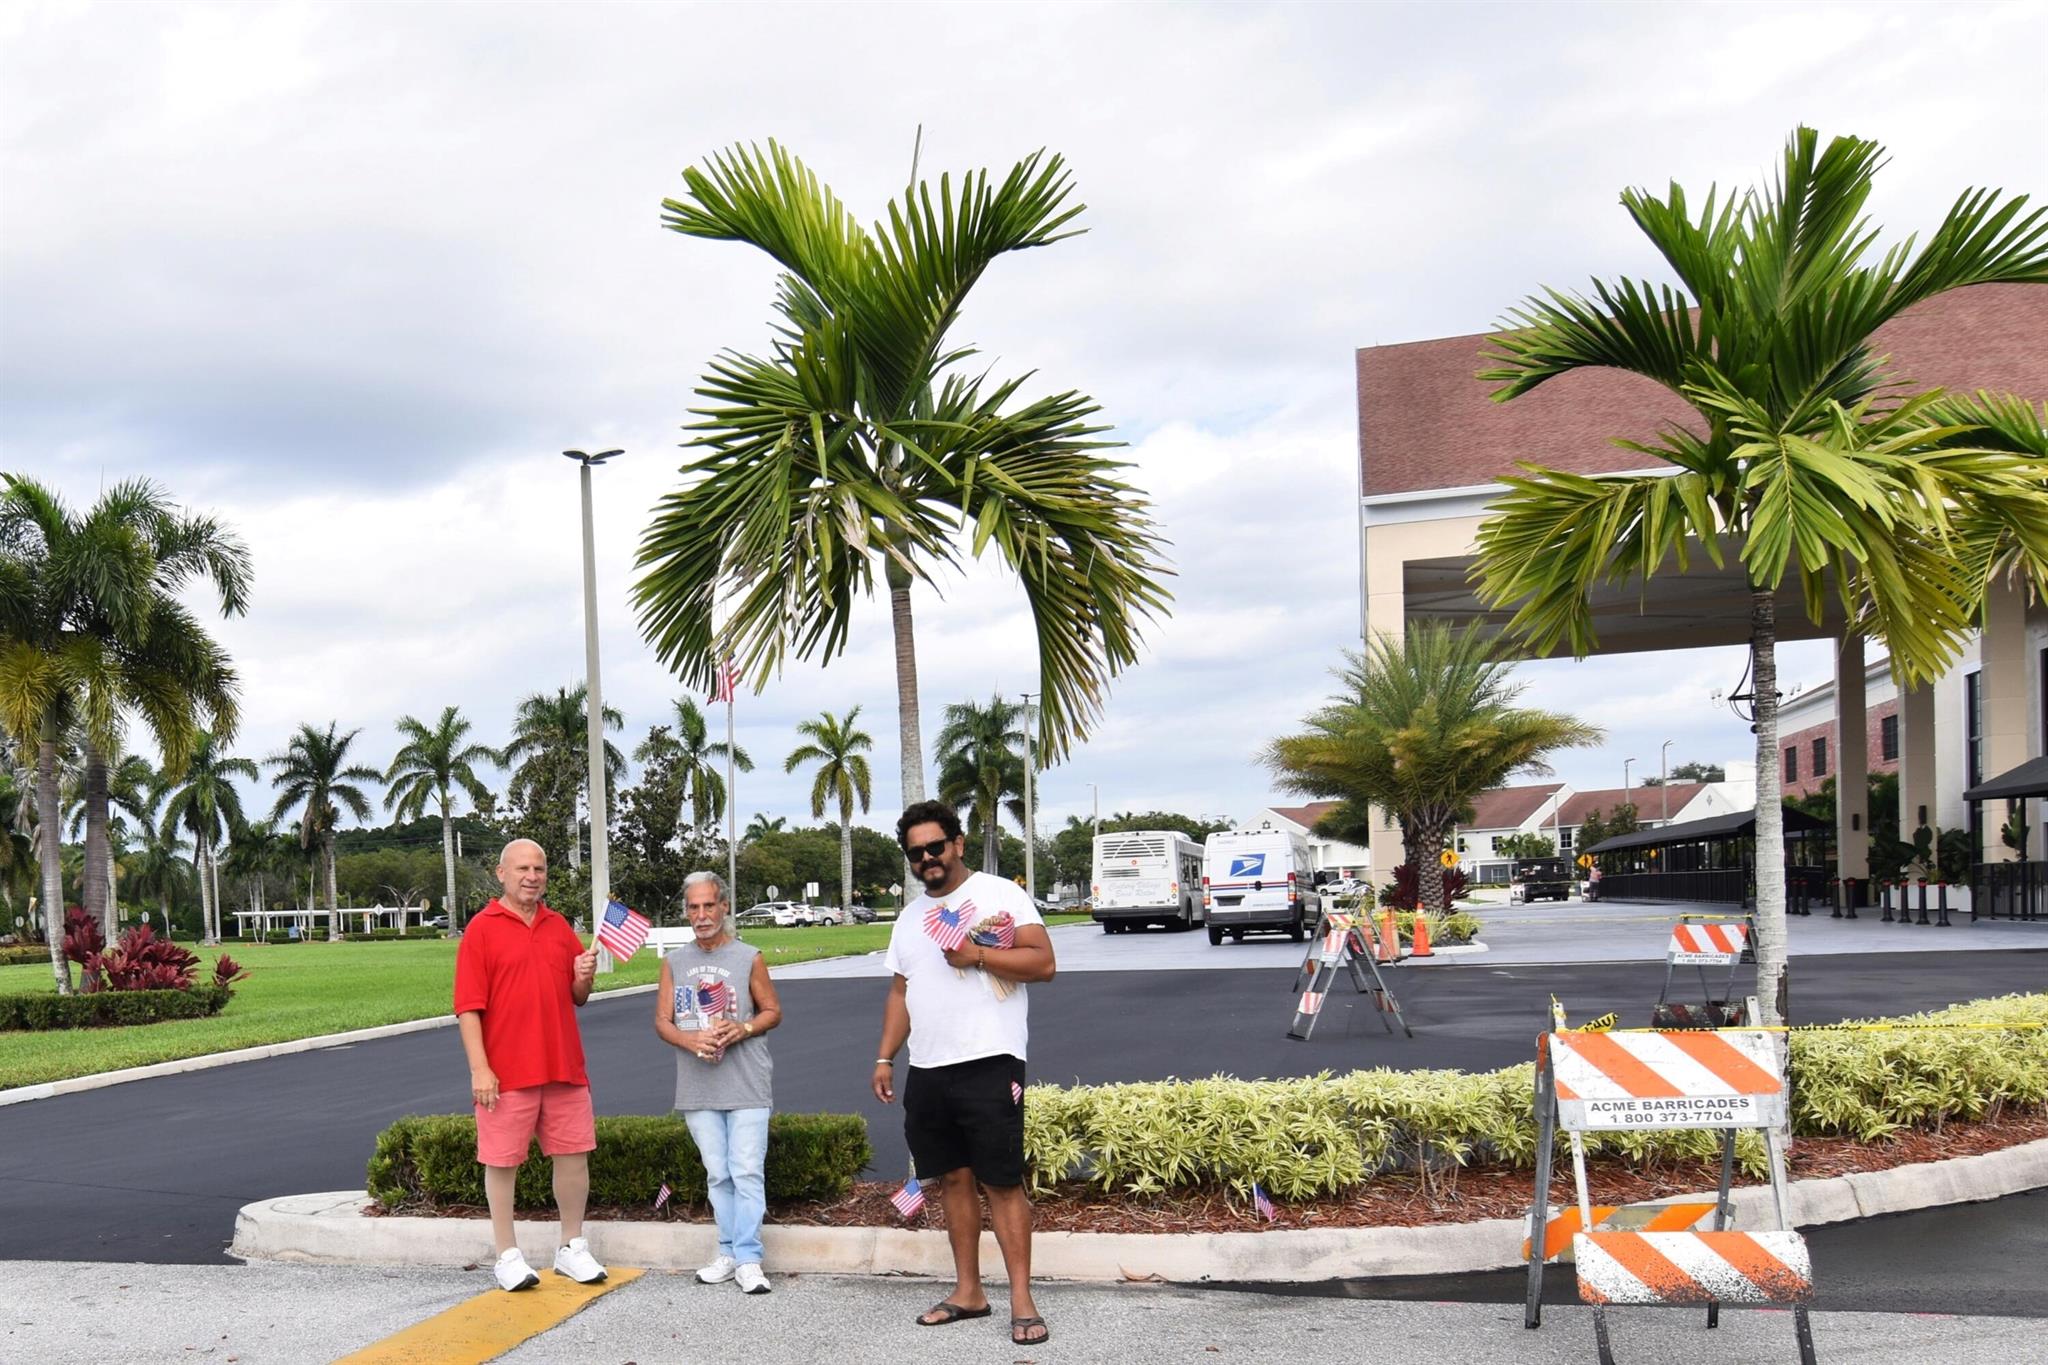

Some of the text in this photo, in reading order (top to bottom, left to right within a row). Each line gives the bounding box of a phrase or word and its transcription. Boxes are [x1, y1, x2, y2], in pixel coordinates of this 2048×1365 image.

[1591, 1098, 1750, 1112] ACME BARRICADES
[1610, 1111, 1733, 1123] 1 800 373-7704
